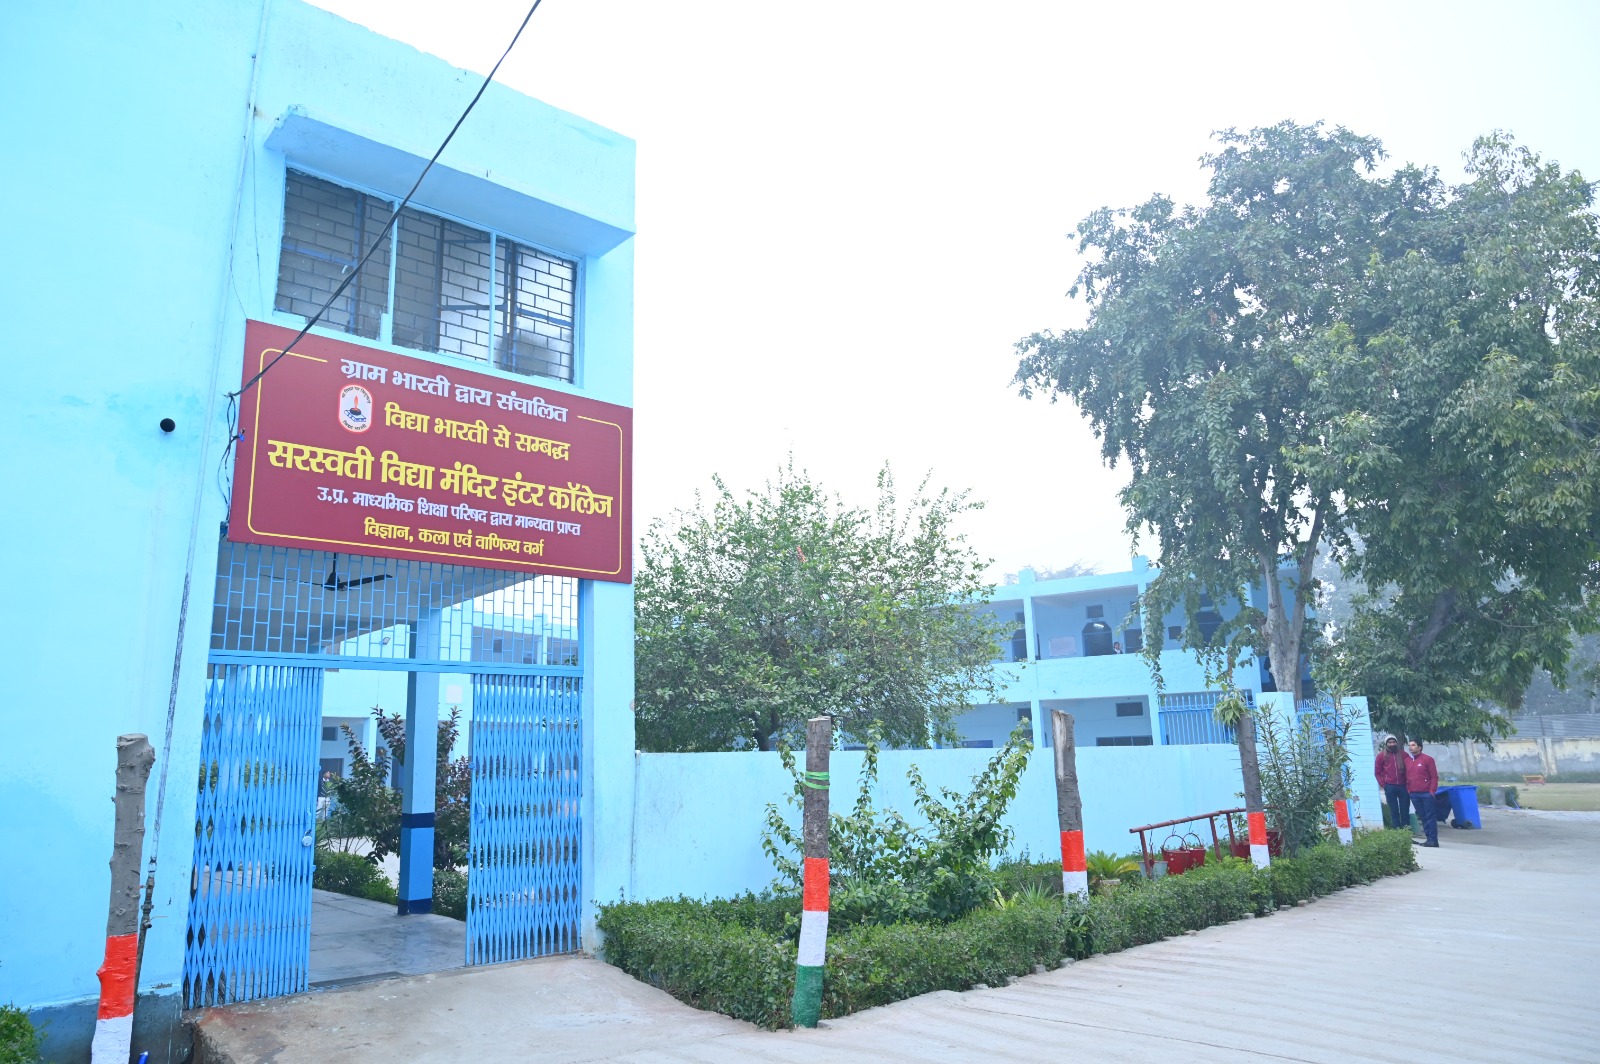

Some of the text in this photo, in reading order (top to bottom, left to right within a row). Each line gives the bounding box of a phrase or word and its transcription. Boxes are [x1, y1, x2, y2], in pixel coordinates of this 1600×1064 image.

[341, 359, 387, 384] ग्राम
[392, 371, 451, 397] भारती
[455, 384, 492, 406] द्वारा
[496, 390, 568, 422] संचालित
[385, 402, 430, 432] विद्या
[434, 418, 489, 444] भारती
[494, 425, 511, 448] से
[516, 434, 570, 460] सम्बद्ध
[268, 440, 613, 517] सरस्वती विद्या मंदिर इंटर कॉलेज
[318, 487, 581, 535] उ.प्र. माध्यमिक शिक्षा परिषद द्वारा मान्यता प्राप्त
[363, 517, 544, 556] विज्ञान, कला एवं वाणिज्य वर्ग
